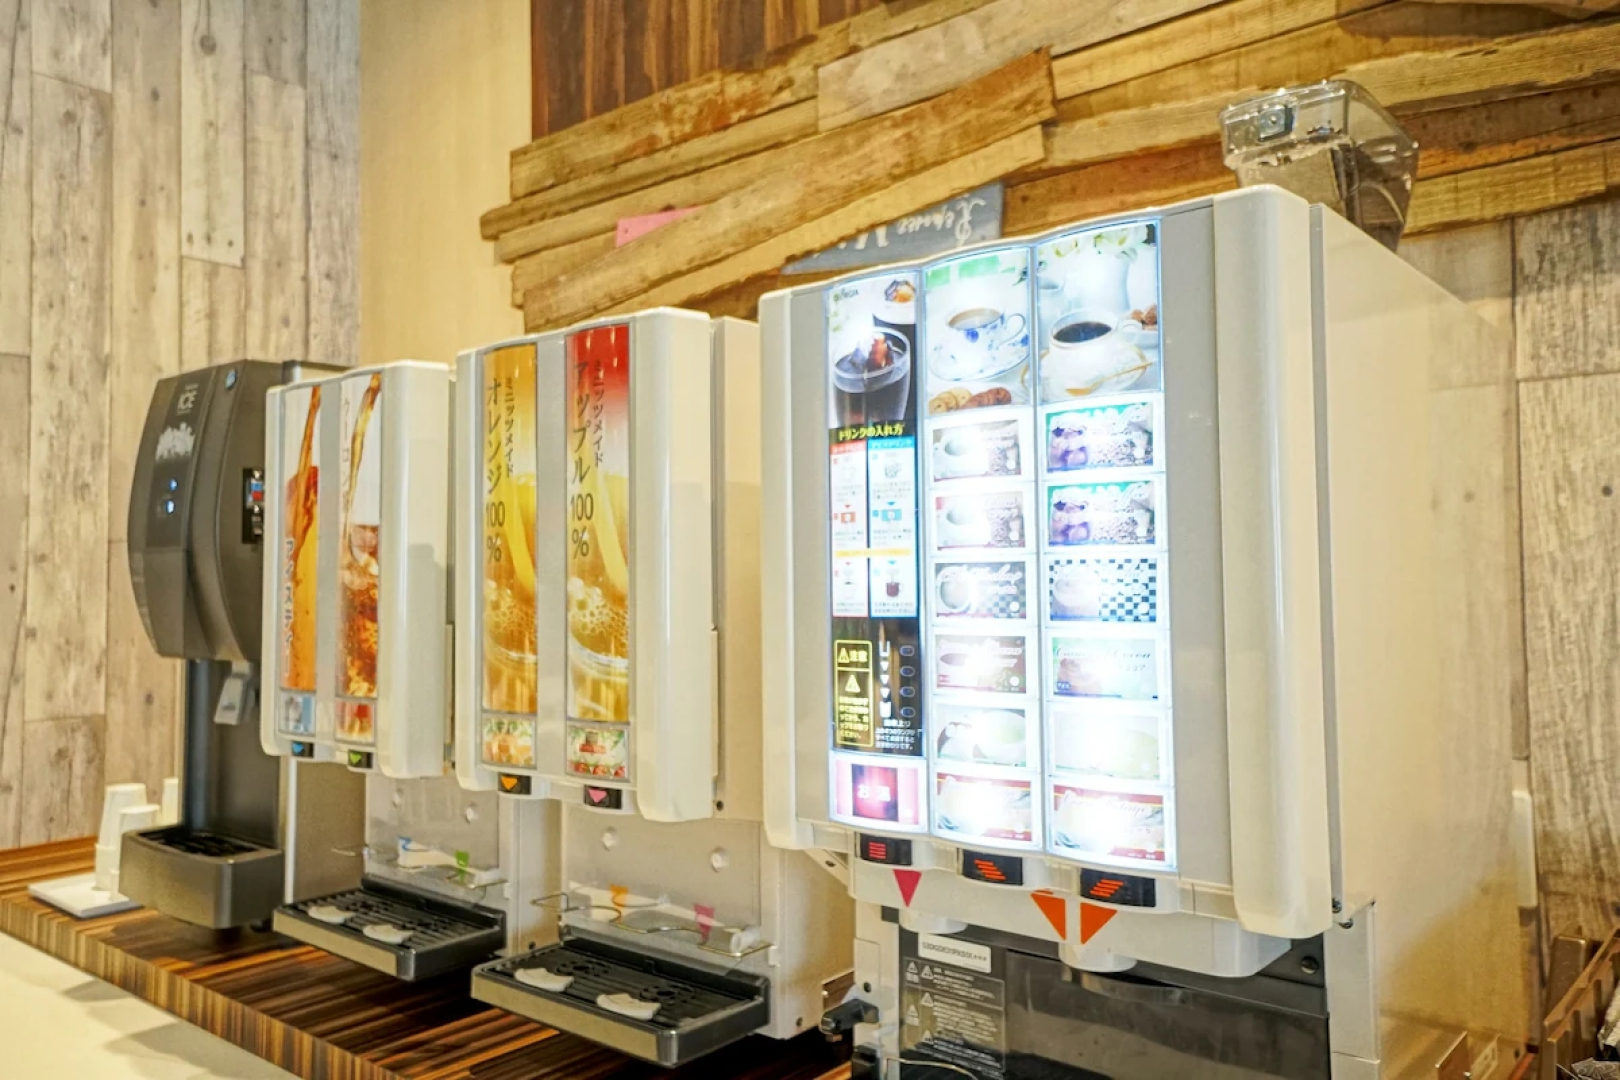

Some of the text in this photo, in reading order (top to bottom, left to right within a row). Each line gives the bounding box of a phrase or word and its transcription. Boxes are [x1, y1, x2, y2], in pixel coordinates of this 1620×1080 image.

[838, 422, 906, 442] ドリンクの入れ方
